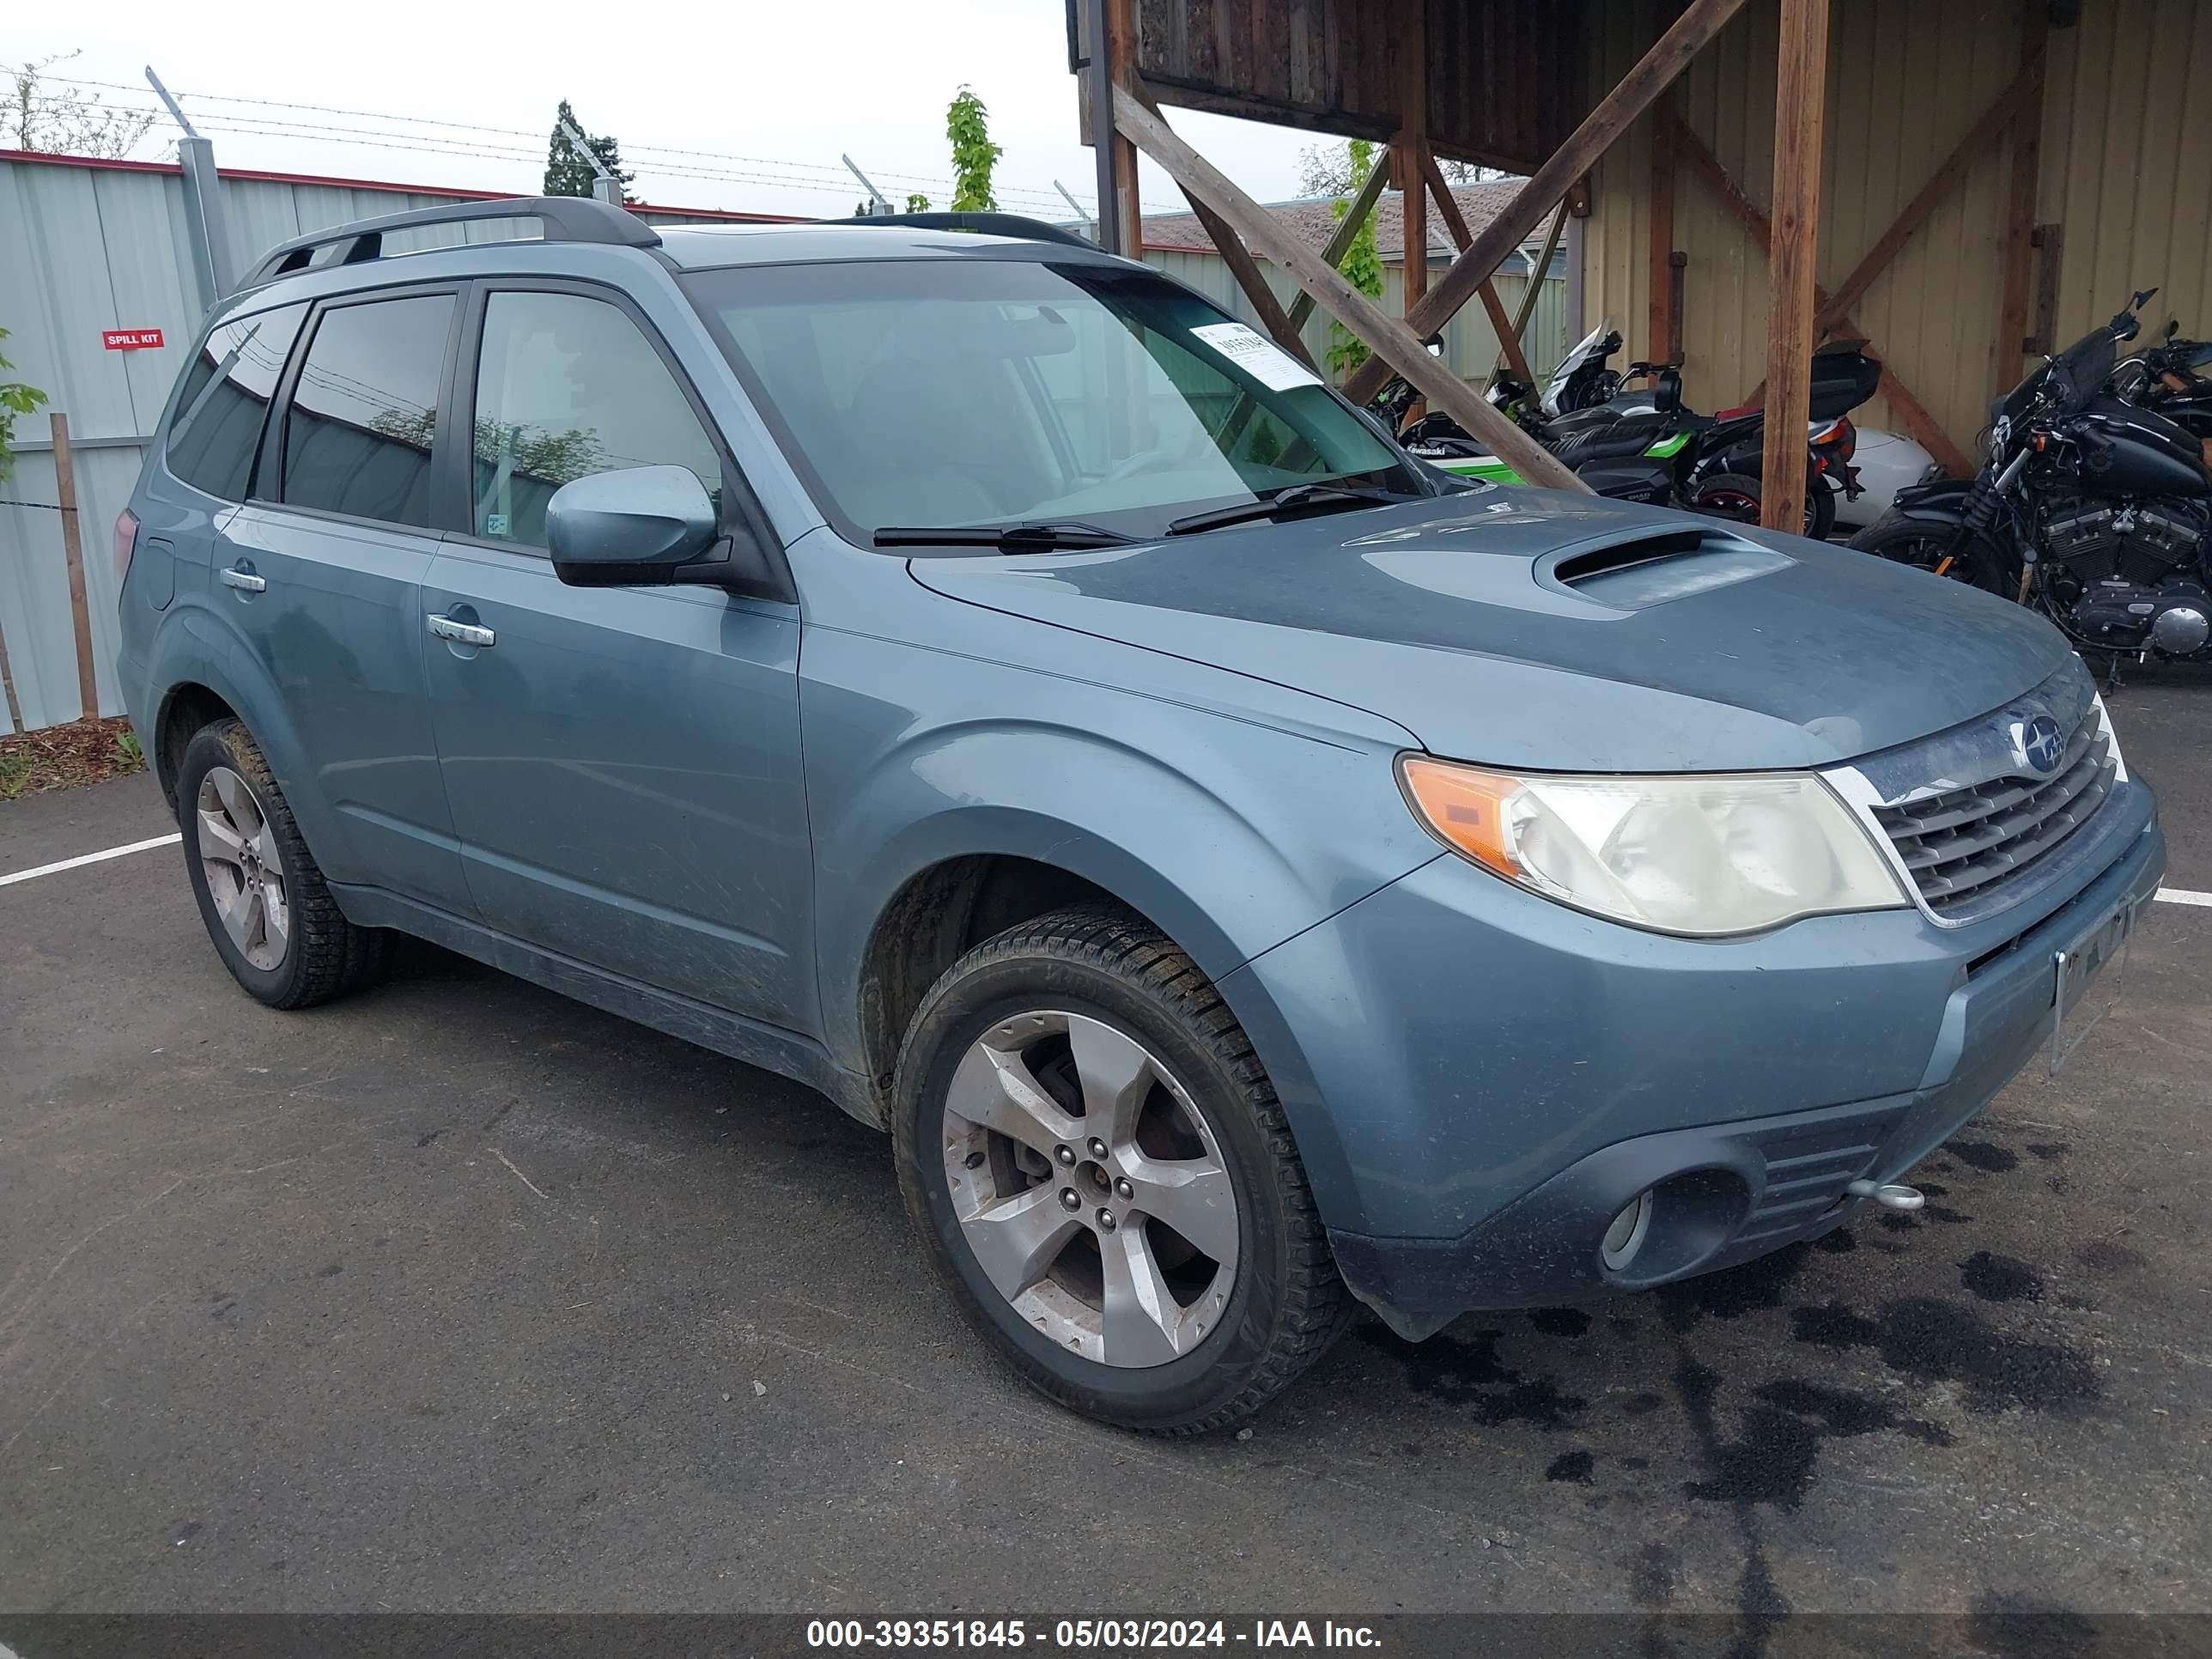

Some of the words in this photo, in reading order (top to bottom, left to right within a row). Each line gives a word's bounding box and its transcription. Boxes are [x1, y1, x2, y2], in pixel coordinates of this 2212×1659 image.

[107, 335, 139, 345] SPILL
[140, 334, 159, 343] KIT
[1407, 445, 1446, 456] Kawasaki
